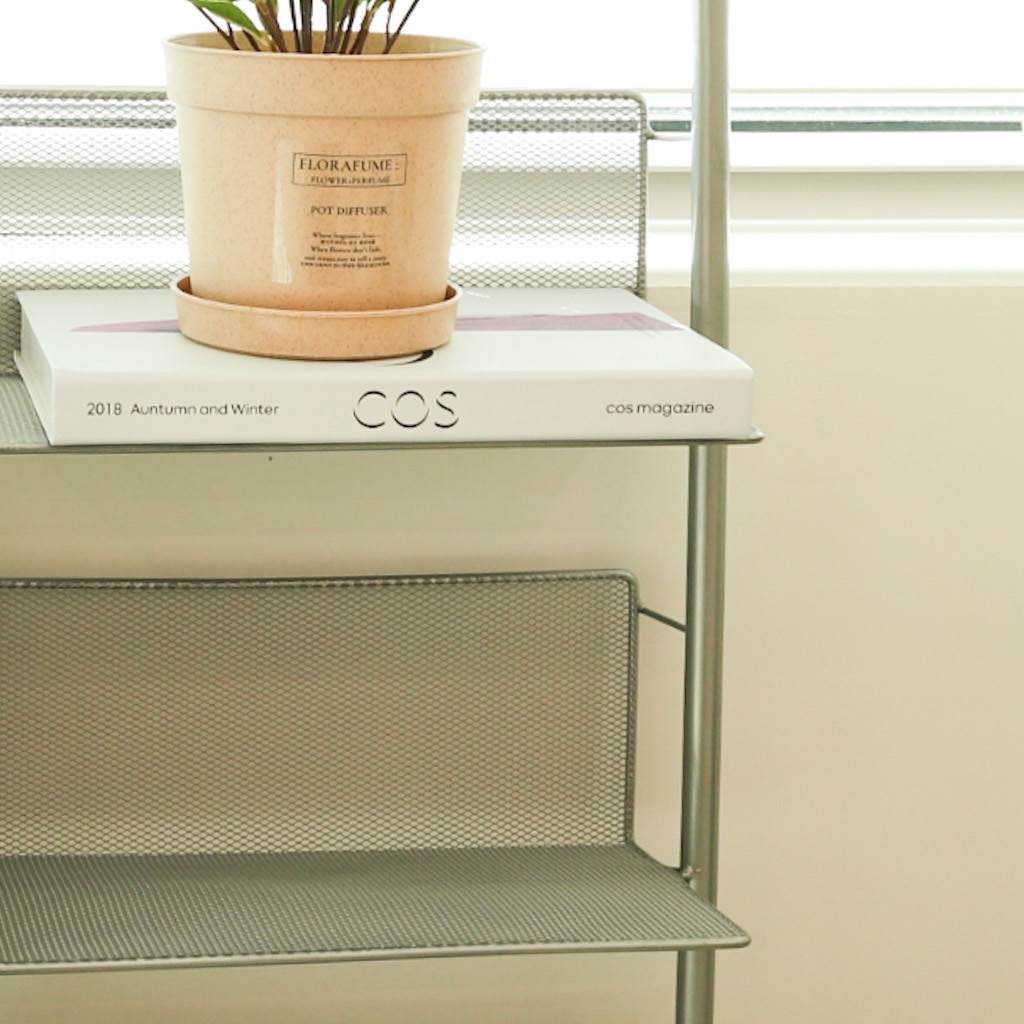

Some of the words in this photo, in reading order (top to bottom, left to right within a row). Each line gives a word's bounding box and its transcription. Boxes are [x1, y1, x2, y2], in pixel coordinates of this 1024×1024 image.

[310, 205, 334, 216] POT
[337, 206, 388, 216] DIFFUSER
[87, 402, 123, 416] 2018
[130, 403, 197, 416] Auntumn
[199, 403, 228, 416] and
[230, 403, 280, 416] Winter
[353, 389, 459, 429] COS
[605, 403, 634, 414] cos
[636, 400, 715, 418] magazine
